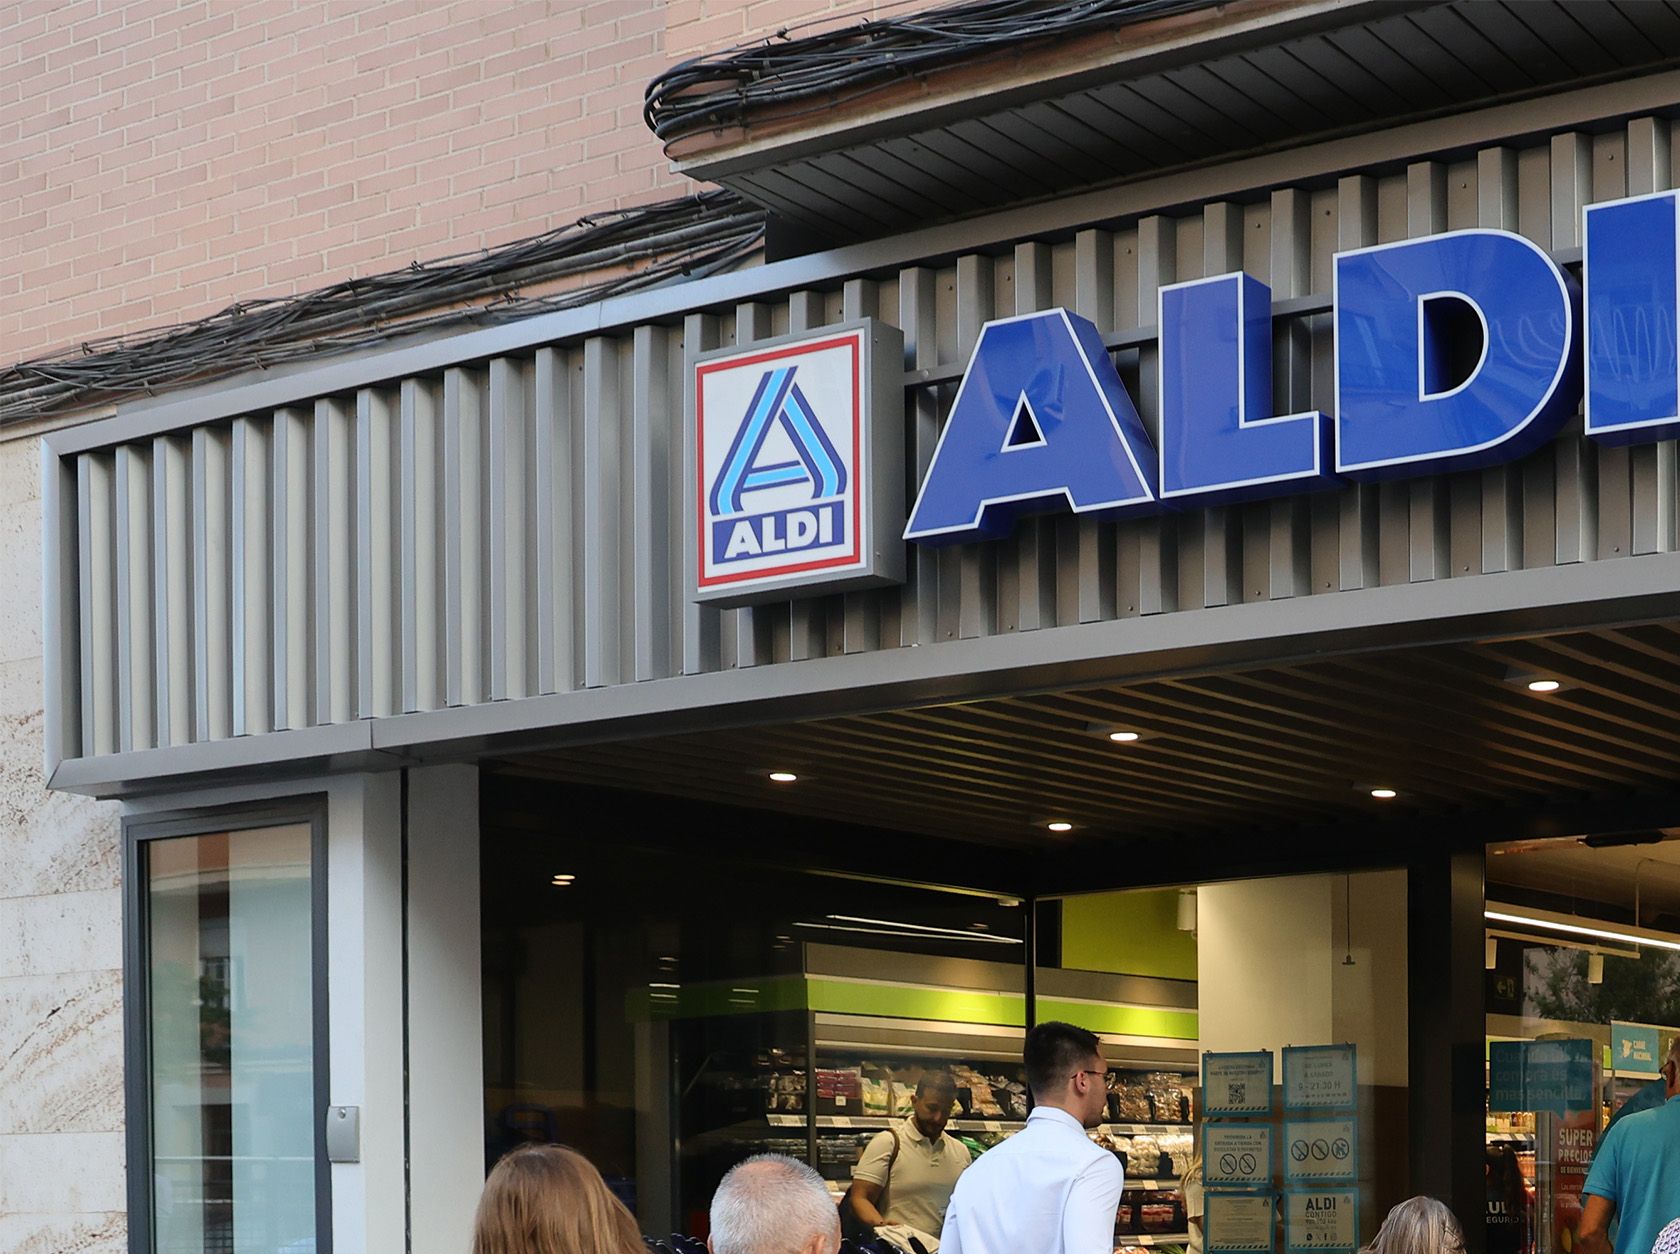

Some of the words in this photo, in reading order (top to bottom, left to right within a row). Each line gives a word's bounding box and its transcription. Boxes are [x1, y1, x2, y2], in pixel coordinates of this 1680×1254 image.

[724, 506, 833, 559] ALDI
[1559, 1128, 1593, 1147] SUPER
[1305, 1197, 1336, 1210] ALDI
